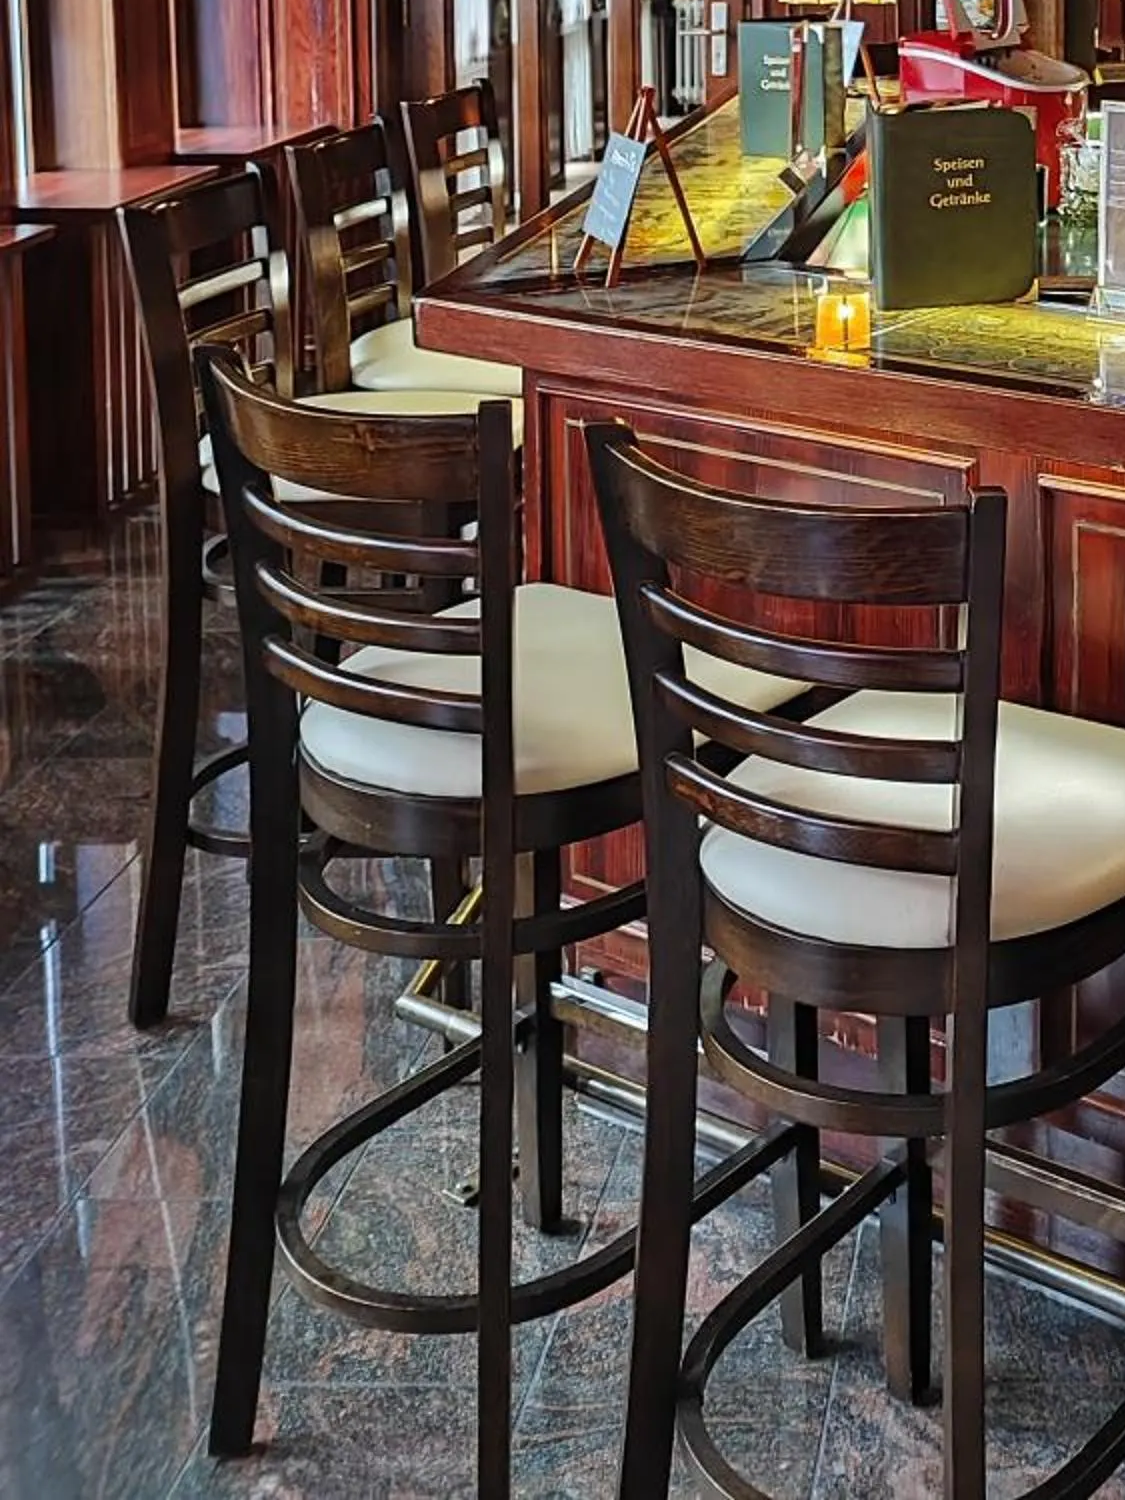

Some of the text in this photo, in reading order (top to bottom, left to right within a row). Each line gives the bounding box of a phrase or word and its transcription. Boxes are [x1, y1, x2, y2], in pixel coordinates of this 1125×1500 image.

[933, 157, 985, 173] Speisen
[946, 173, 973, 189] und
[929, 191, 992, 209] Getränke
